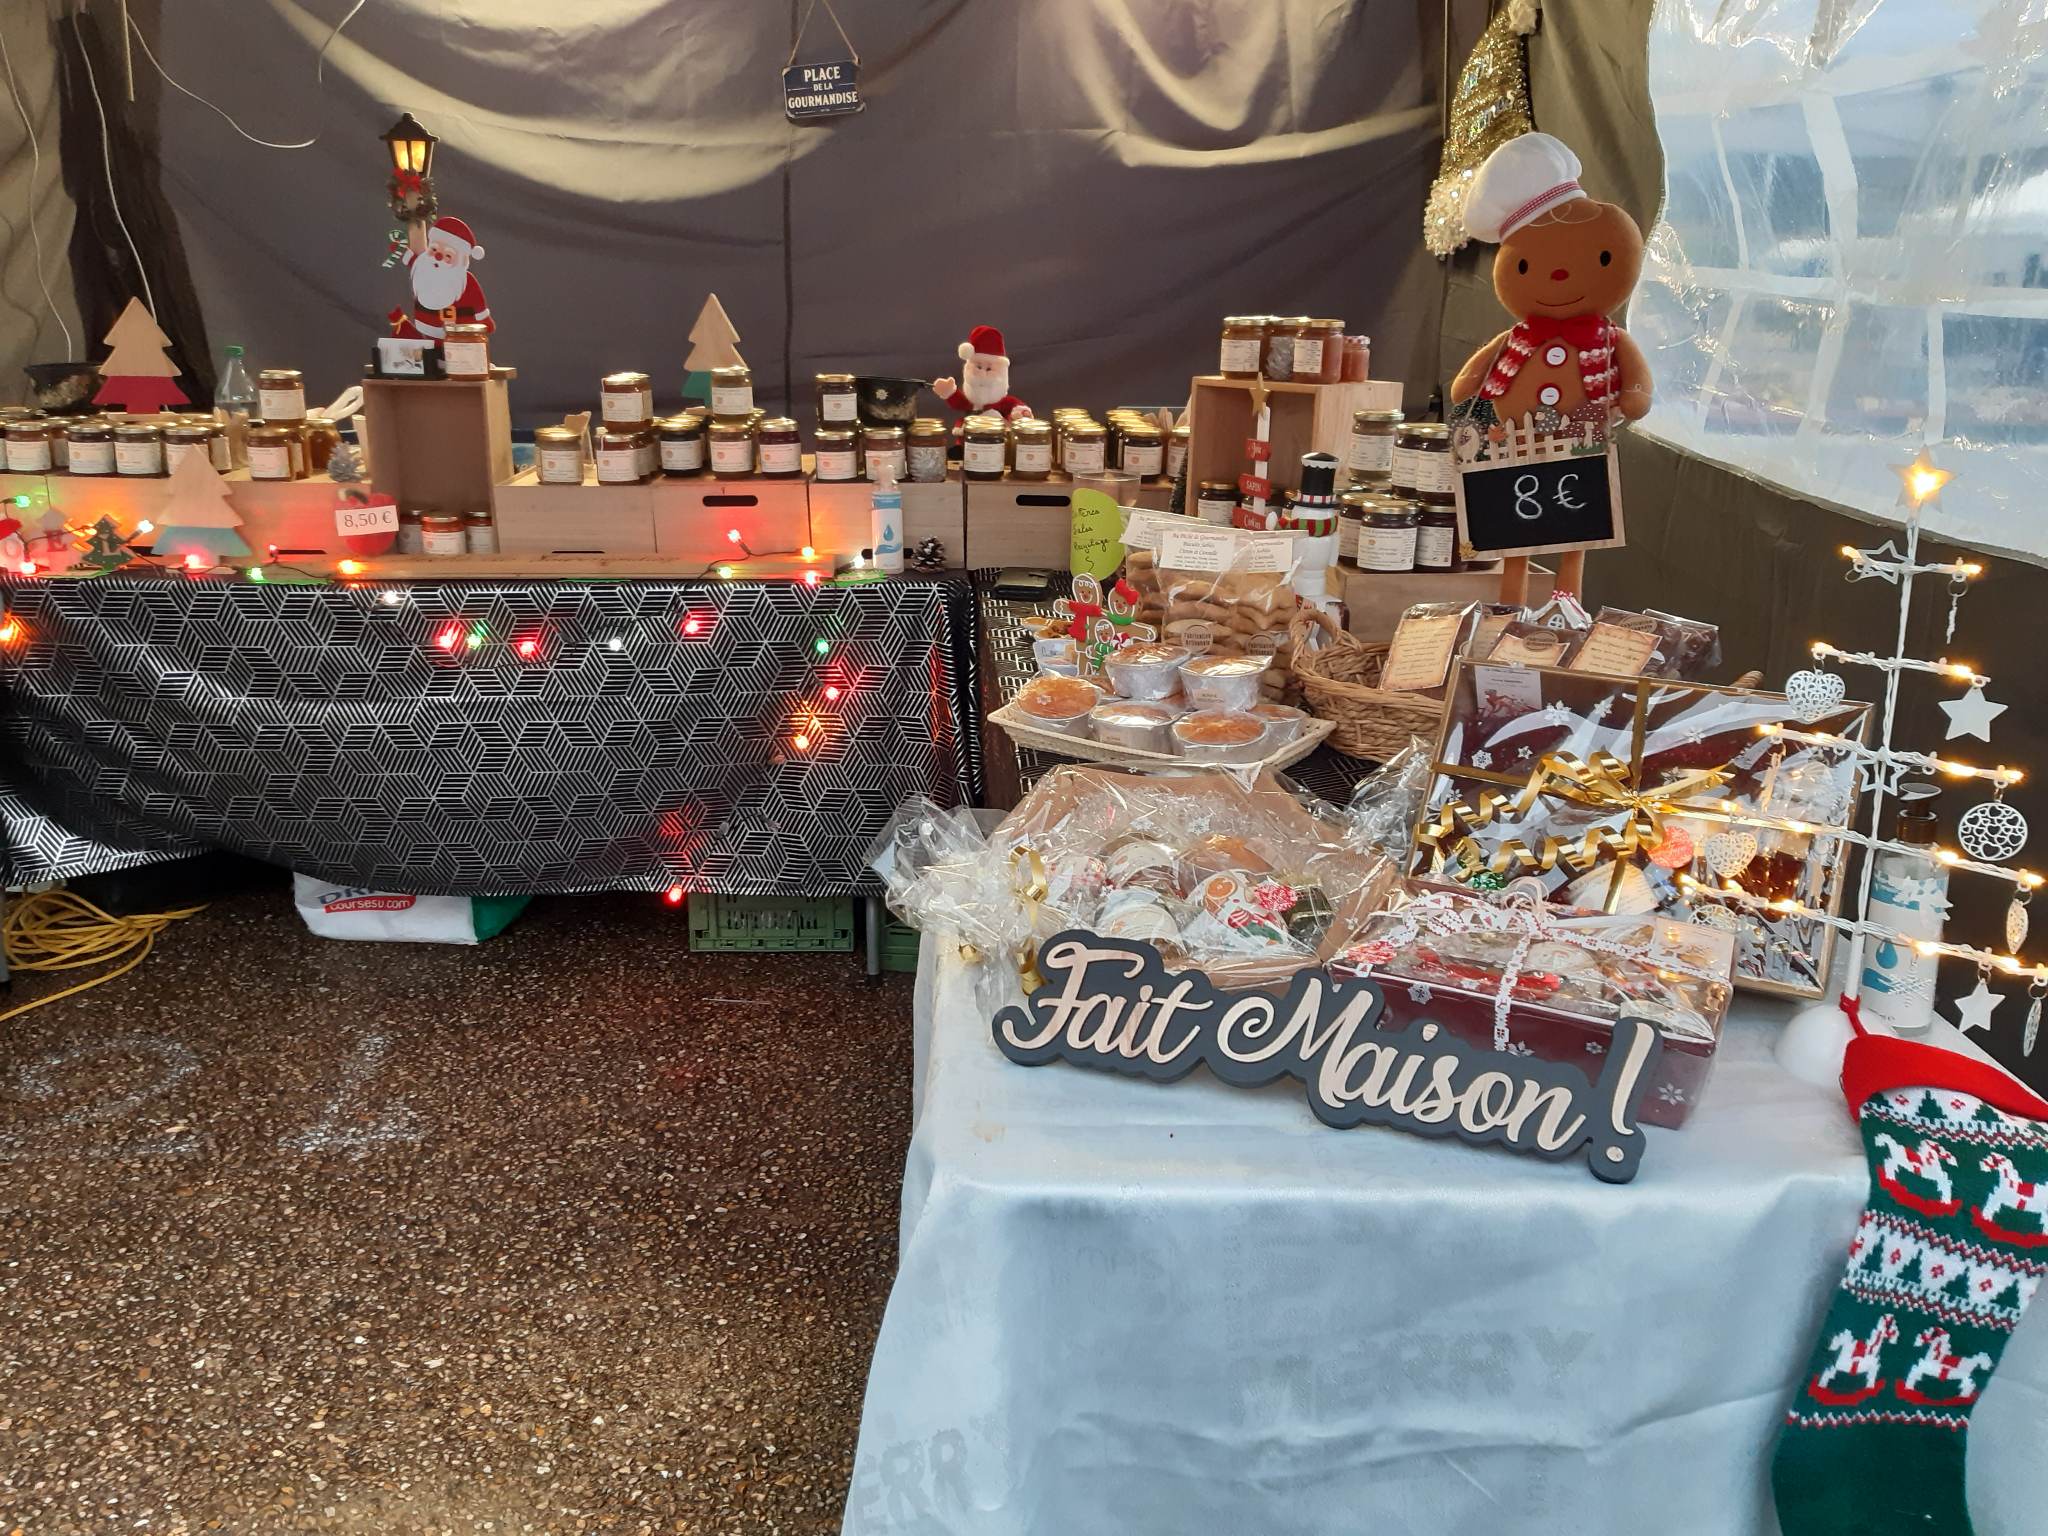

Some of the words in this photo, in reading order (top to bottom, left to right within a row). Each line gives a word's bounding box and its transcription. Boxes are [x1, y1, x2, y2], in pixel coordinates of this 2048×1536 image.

[804, 66, 840, 82] PLACE
[813, 83, 823, 91] DE
[823, 82, 833, 91] LA
[788, 91, 858, 109] GOURMANDISE
[1514, 474, 1543, 520] 8
[1552, 473, 1587, 509] €
[344, 512, 377, 528] 8,50
[383, 510, 393, 524] €
[1001, 941, 1213, 1065] Fait
[1216, 977, 1587, 1151] Maison
[1609, 1023, 1654, 1162] !
